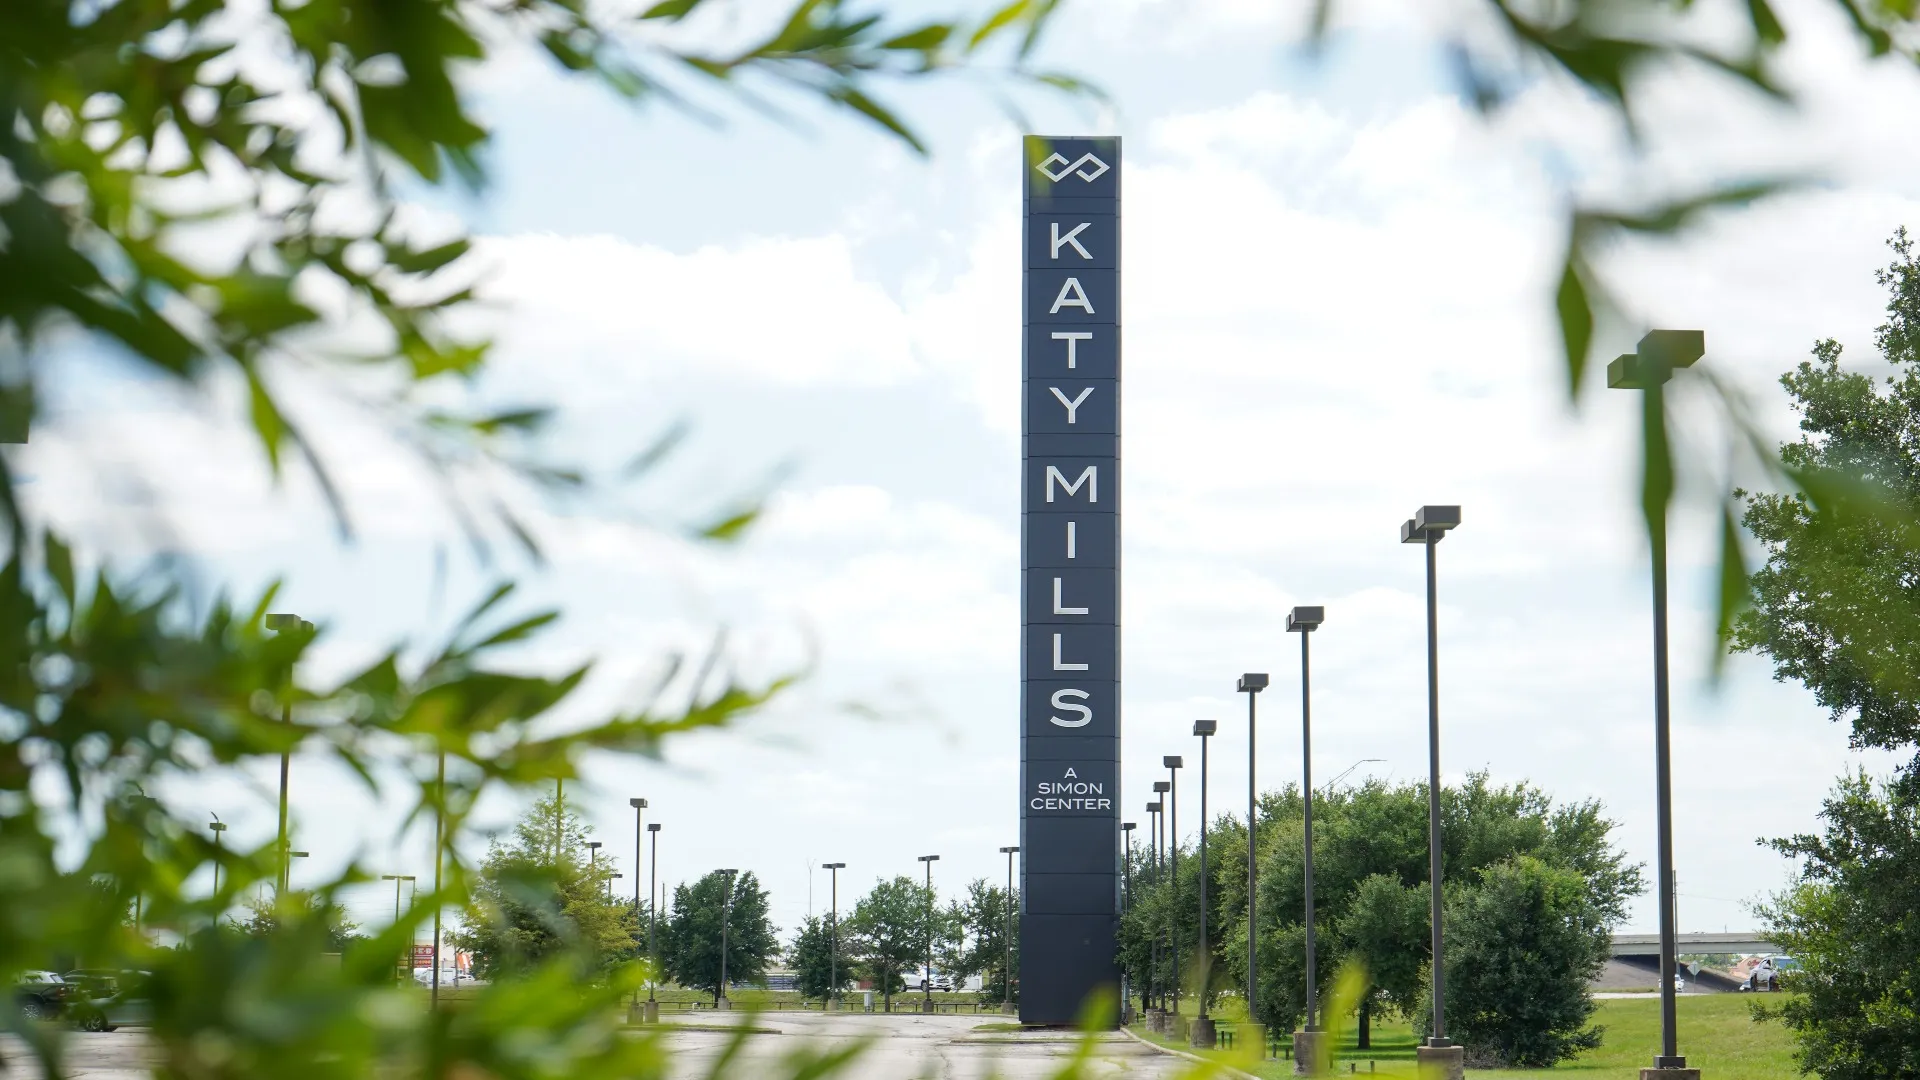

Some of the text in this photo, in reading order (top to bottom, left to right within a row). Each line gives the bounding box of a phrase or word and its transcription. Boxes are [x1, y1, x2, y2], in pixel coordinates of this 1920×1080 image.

[1047, 223, 1097, 728] KATY MILLS
[1064, 767, 1078, 779] A
[1038, 782, 1103, 795] SIMON
[1030, 797, 1111, 810] CENTER
